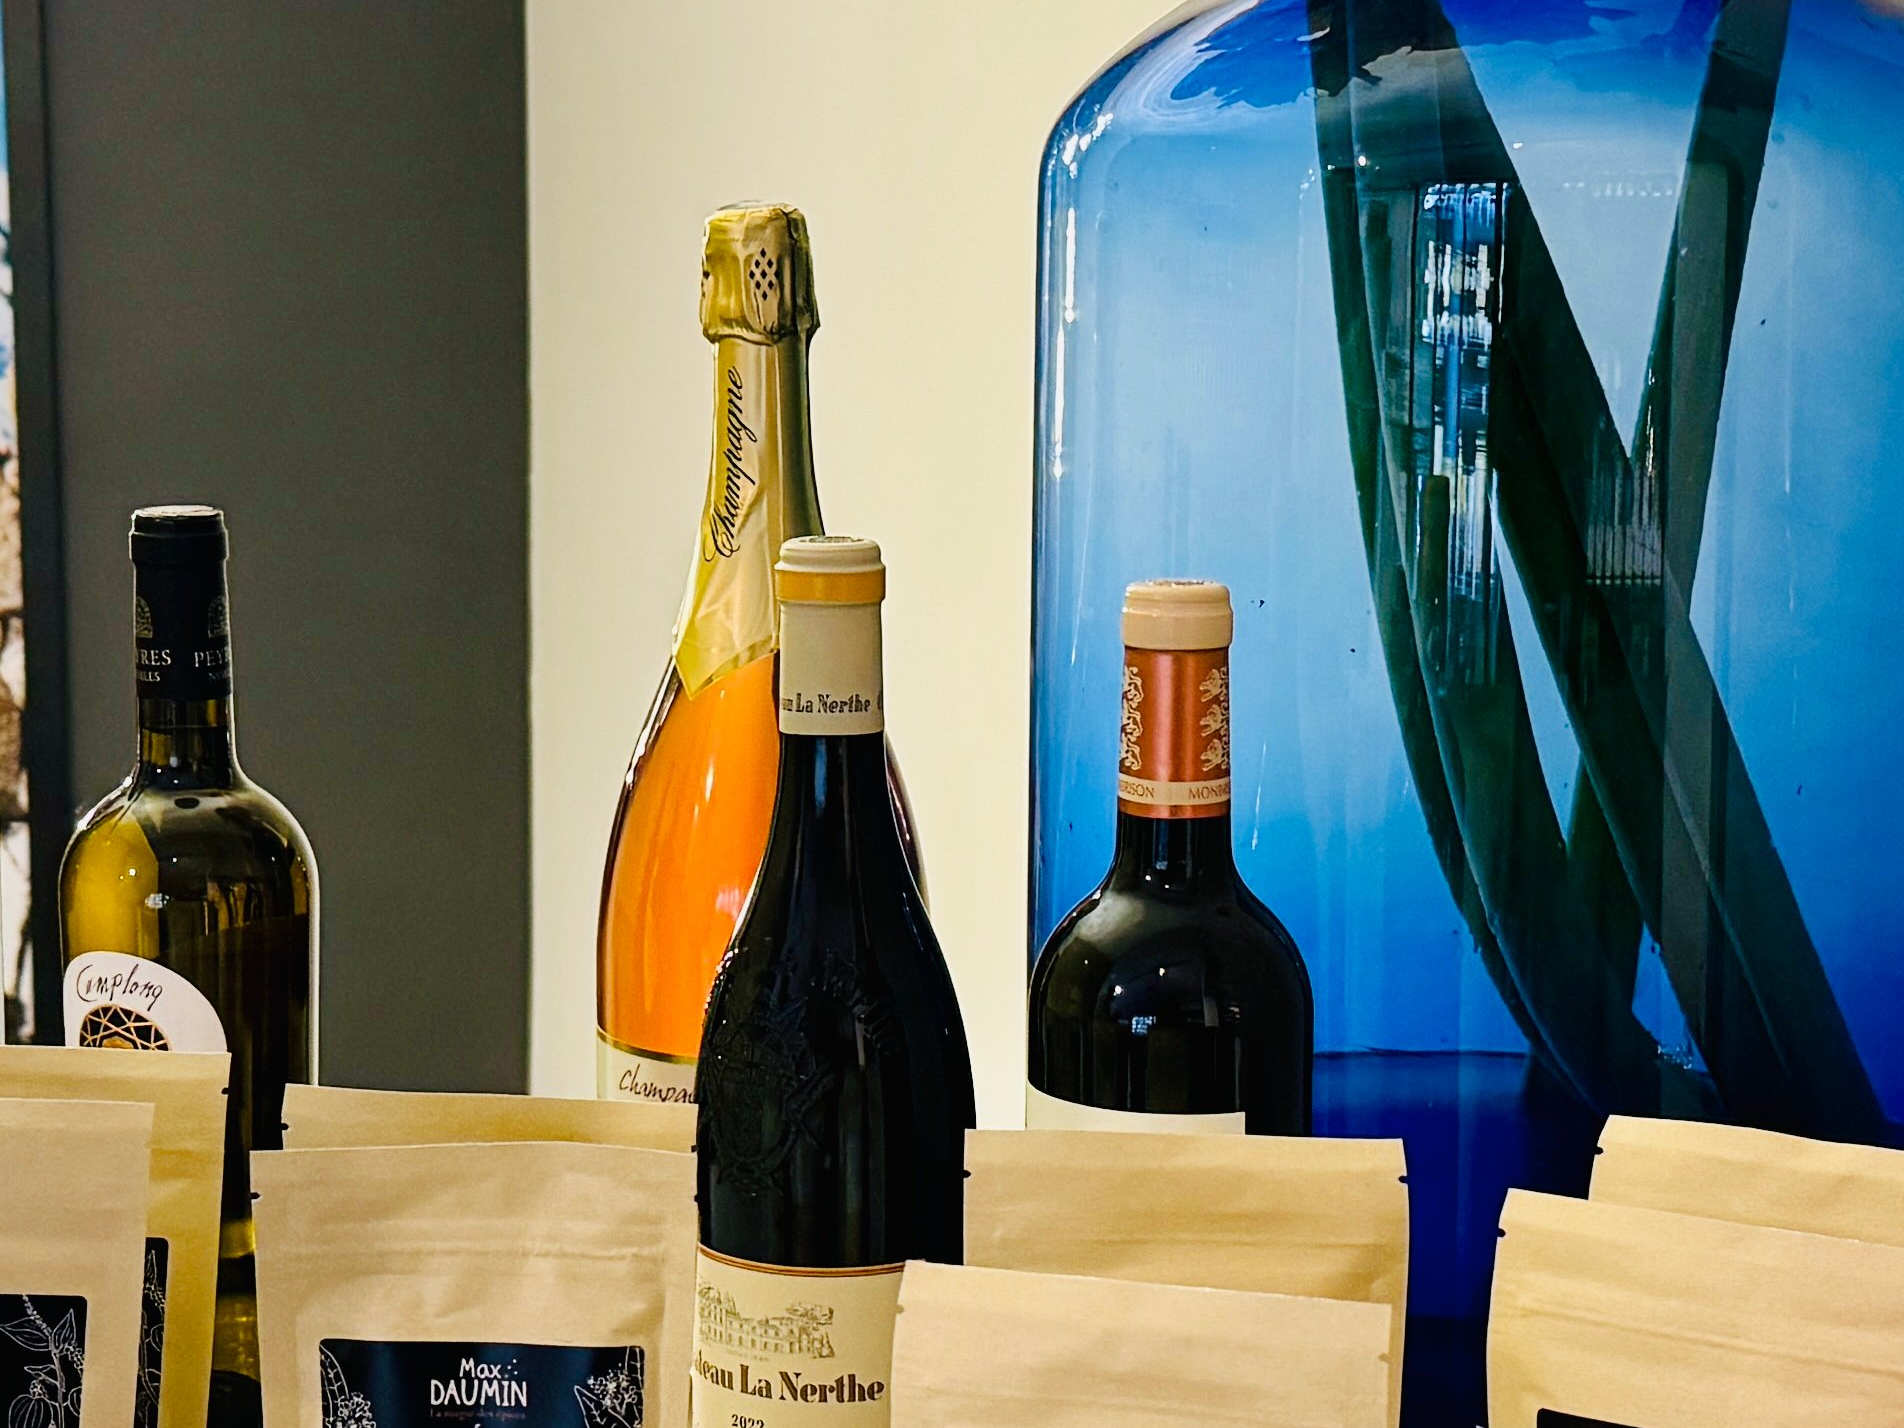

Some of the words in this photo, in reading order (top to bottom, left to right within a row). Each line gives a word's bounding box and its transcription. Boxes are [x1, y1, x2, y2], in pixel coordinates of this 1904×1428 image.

[704, 366, 758, 562] Champagne
[795, 693, 813, 713] La
[818, 693, 870, 714] Nerthe
[460, 1358, 502, 1379] Max
[695, 1349, 734, 1390] teau
[740, 1363, 773, 1399] La
[778, 1371, 885, 1403] Nerthe
[430, 1379, 527, 1407] DAUMIN
